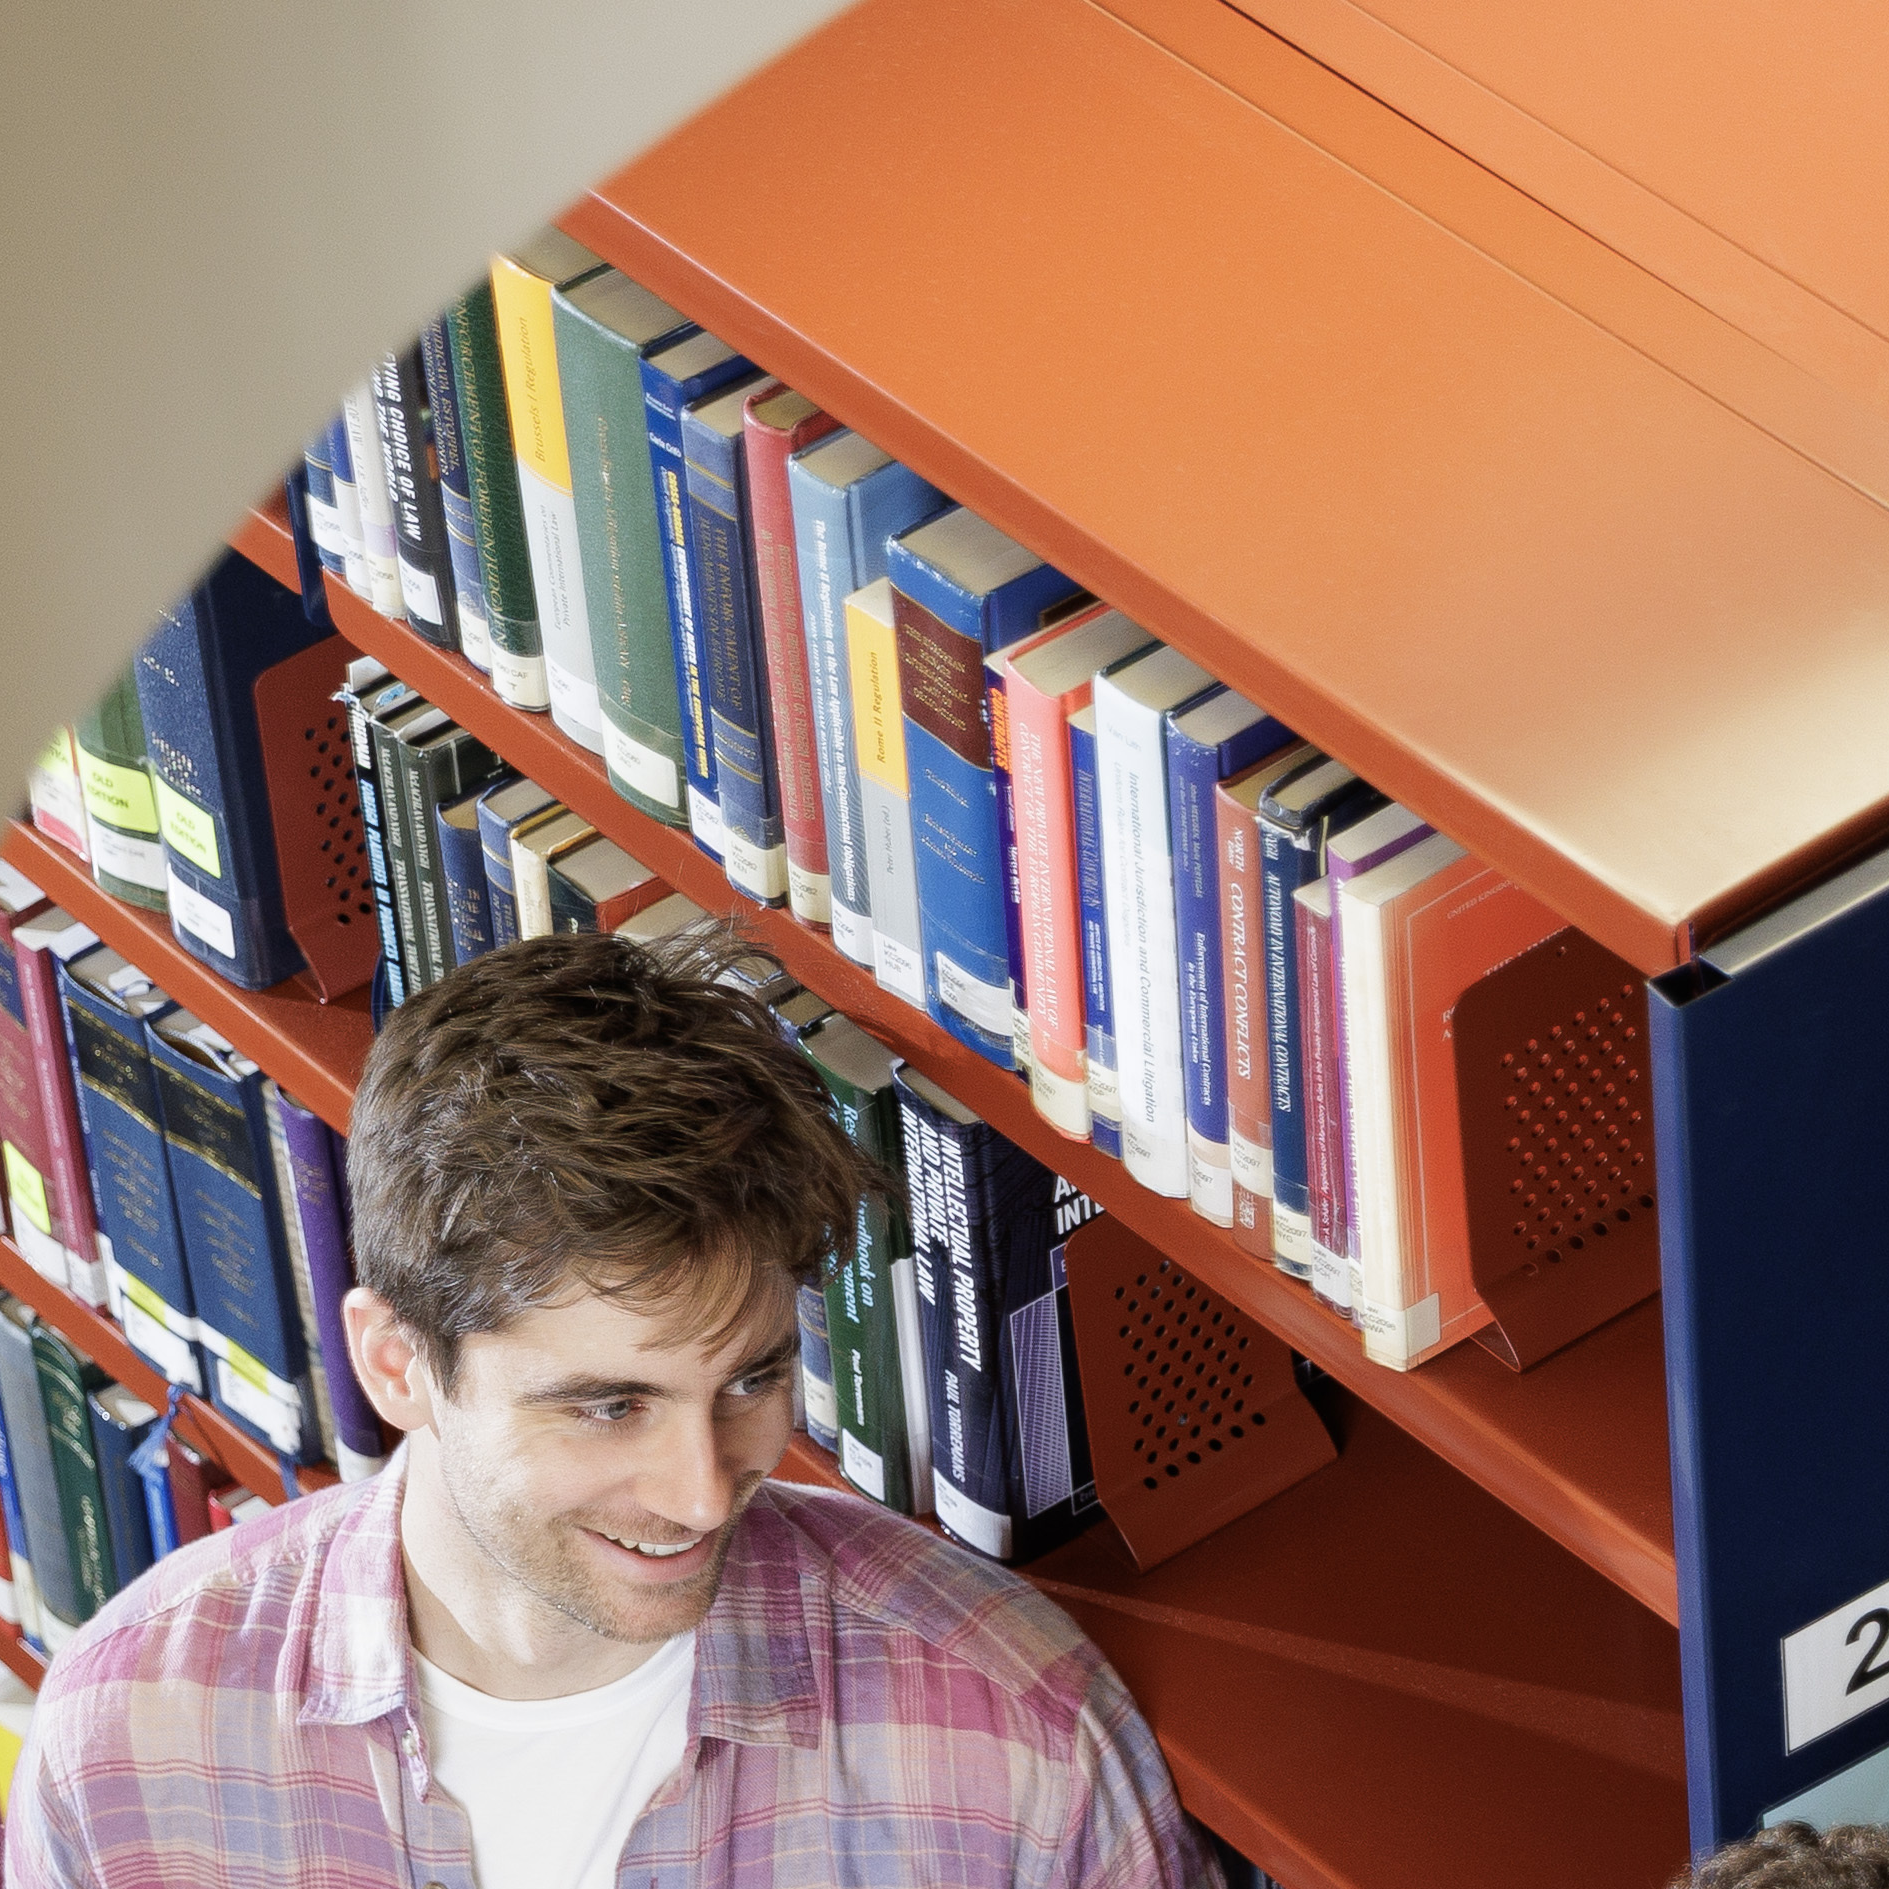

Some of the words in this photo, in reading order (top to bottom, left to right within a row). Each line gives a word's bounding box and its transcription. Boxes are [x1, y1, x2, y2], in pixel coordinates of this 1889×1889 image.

[517, 313, 537, 394] Regulation
[374, 399, 389, 438] THE
[388, 404, 411, 472] CHOICE
[528, 403, 547, 465] Brussels
[380, 439, 400, 503] WORLD
[471, 436, 485, 464] OF
[398, 473, 416, 500] OF
[475, 465, 496, 557] FOREIGN
[402, 500, 422, 542] LAW
[550, 509, 559, 532] Law
[714, 525, 728, 562] THE
[814, 515, 826, 541] The
[541, 517, 556, 587] Commentaries
[552, 531, 566, 592] International
[816, 538, 829, 572] Rome
[549, 585, 562, 632] European
[558, 590, 571, 628] Private
[819, 580, 834, 641] Regulation
[689, 674, 700, 698] THE
[826, 654, 837, 676] the
[827, 673, 839, 697] Law
[868, 648, 882, 715] Regulation
[691, 694, 706, 749] EUROPEAN
[829, 695, 843, 752] Applicable
[874, 726, 886, 765] Rome
[988, 685, 1008, 773] CONTRACTS
[1028, 728, 1042, 765] THE
[92, 770, 115, 789] OLD
[1018, 719, 1034, 799] CONTRACT
[1030, 762, 1044, 801] NEW
[87, 783, 130, 811] EDITION
[176, 810, 197, 832] OLD
[835, 762, 851, 845] Non-Contractual
[1023, 796, 1035, 821] OF
[1128, 770, 1143, 862] International
[170, 820, 208, 856] EDITION
[358, 776, 377, 826] FOREIGN
[375, 884, 391, 905] IN
[1024, 823, 1037, 857] THE
[1033, 797, 1048, 861] PRIVATE
[1233, 824, 1244, 873] NORTH
[842, 842, 856, 903] Obligations
[884, 851, 896, 877] Peter
[394, 857, 415, 942] TRANSNATIONAL
[1026, 853, 1042, 932] EUROPEAN
[1036, 857, 1055, 975] INTERNATIONAL
[1132, 859, 1147, 946] Jurisdiction
[1266, 869, 1282, 942] AUTONOMY
[421, 877, 442, 962] TRANSNATIONAL
[882, 939, 897, 952] Law
[1230, 879, 1247, 984] CONTRACT
[1269, 937, 1283, 955] IN
[884, 958, 902, 973] HUB
[1031, 929, 1047, 1019] COMMUNITY
[1137, 943, 1149, 976] and
[1186, 970, 1196, 990] the
[1194, 928, 1207, 993] Enforcement
[1043, 972, 1057, 1009] LAW
[1138, 972, 1153, 1060] Commercial
[1187, 987, 1199, 1035] European
[1270, 950, 1288, 1048] INTERNATIONAL
[1045, 1005, 1058, 1030] OF
[1198, 1002, 1210, 1064] International
[1235, 980, 1252, 1082] CONFLICTS
[1189, 1033, 1200, 1065] Union
[1143, 1056, 1156, 1125] Litigation
[1200, 1059, 1212, 1108] Contracts
[1275, 1043, 1292, 1115] CONTRACTS
[920, 1117, 941, 1169] AND
[899, 1101, 930, 1258] INTERNATIONAL
[915, 1251, 935, 1306] LAW
[927, 1163, 952, 1250] PRIVATE
[939, 1132, 970, 1275] INTELLECTUAL
[957, 1269, 982, 1373] PROPERTY
[862, 1281, 876, 1311] on
[849, 1346, 861, 1374] Paul
[851, 1370, 865, 1427] Torremans
[945, 1368, 960, 1408] PAUL
[947, 1403, 966, 1483] TORREMANS
